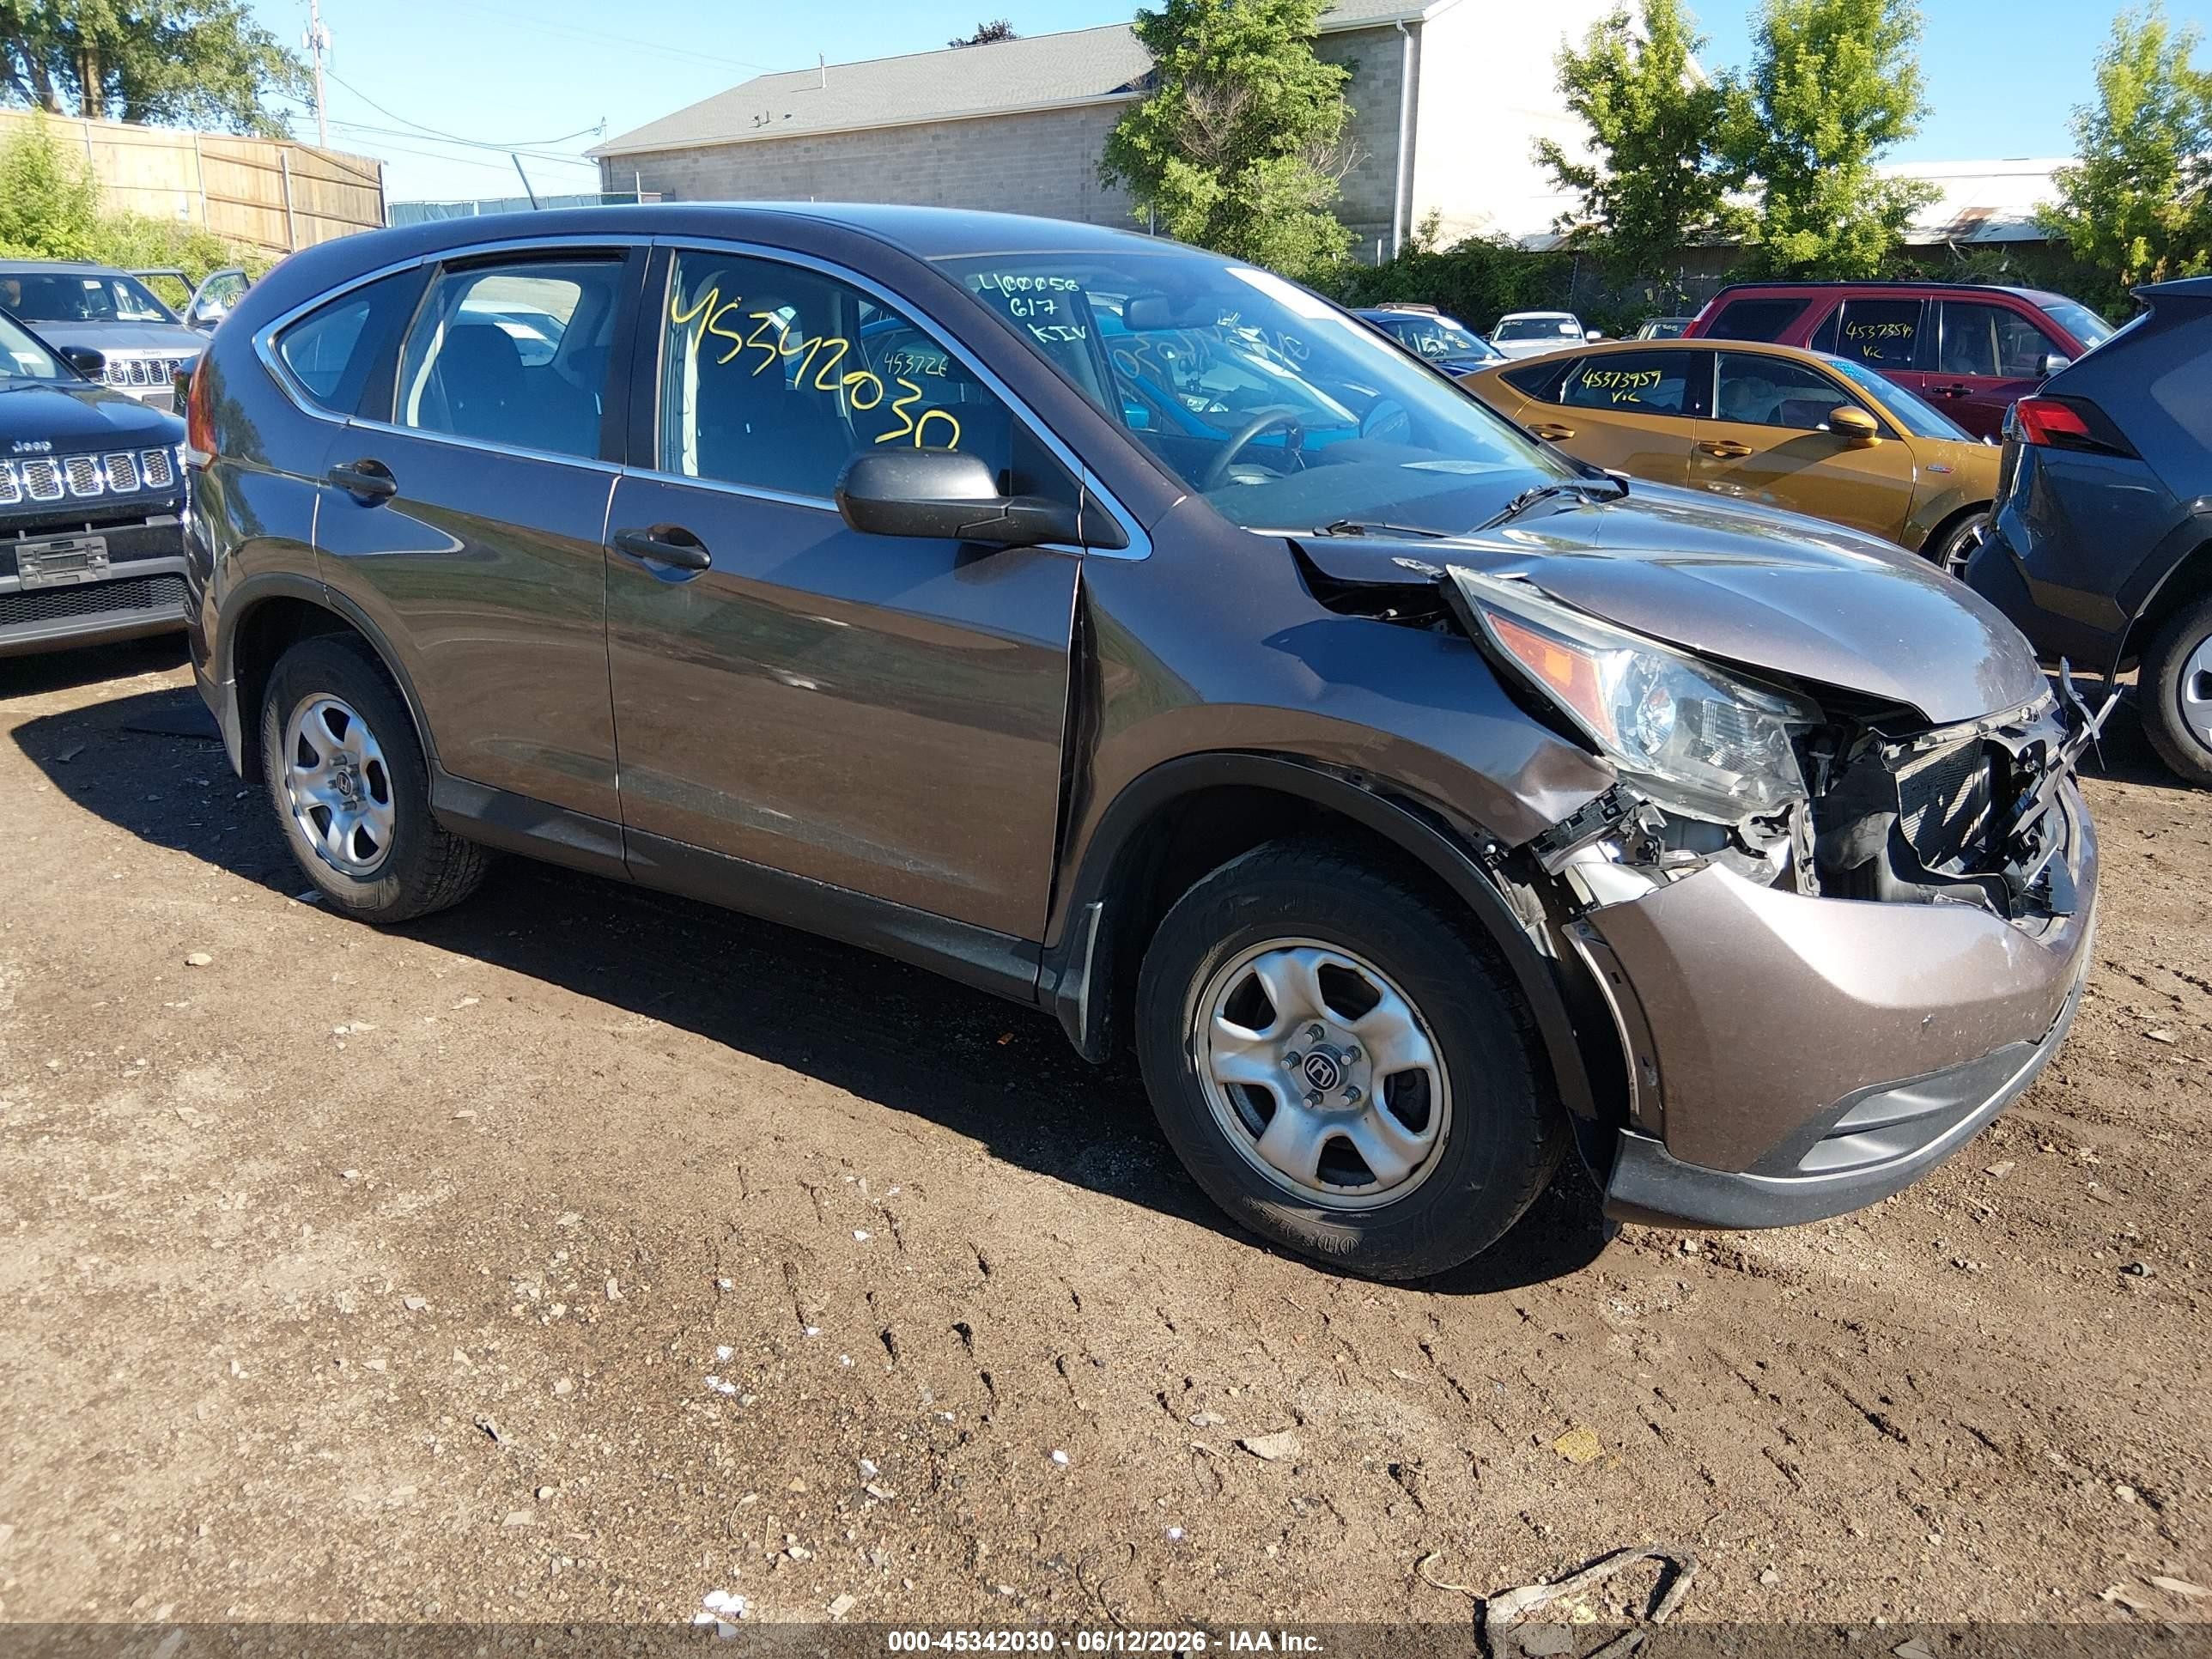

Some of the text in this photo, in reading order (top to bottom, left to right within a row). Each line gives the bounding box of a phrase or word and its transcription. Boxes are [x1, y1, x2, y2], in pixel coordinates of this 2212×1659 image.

[1010, 297, 1059, 317] 617
[672, 288, 960, 448] 45342030
[1582, 367, 1662, 390] 45373959
[11, 441, 52, 453] Jeep
